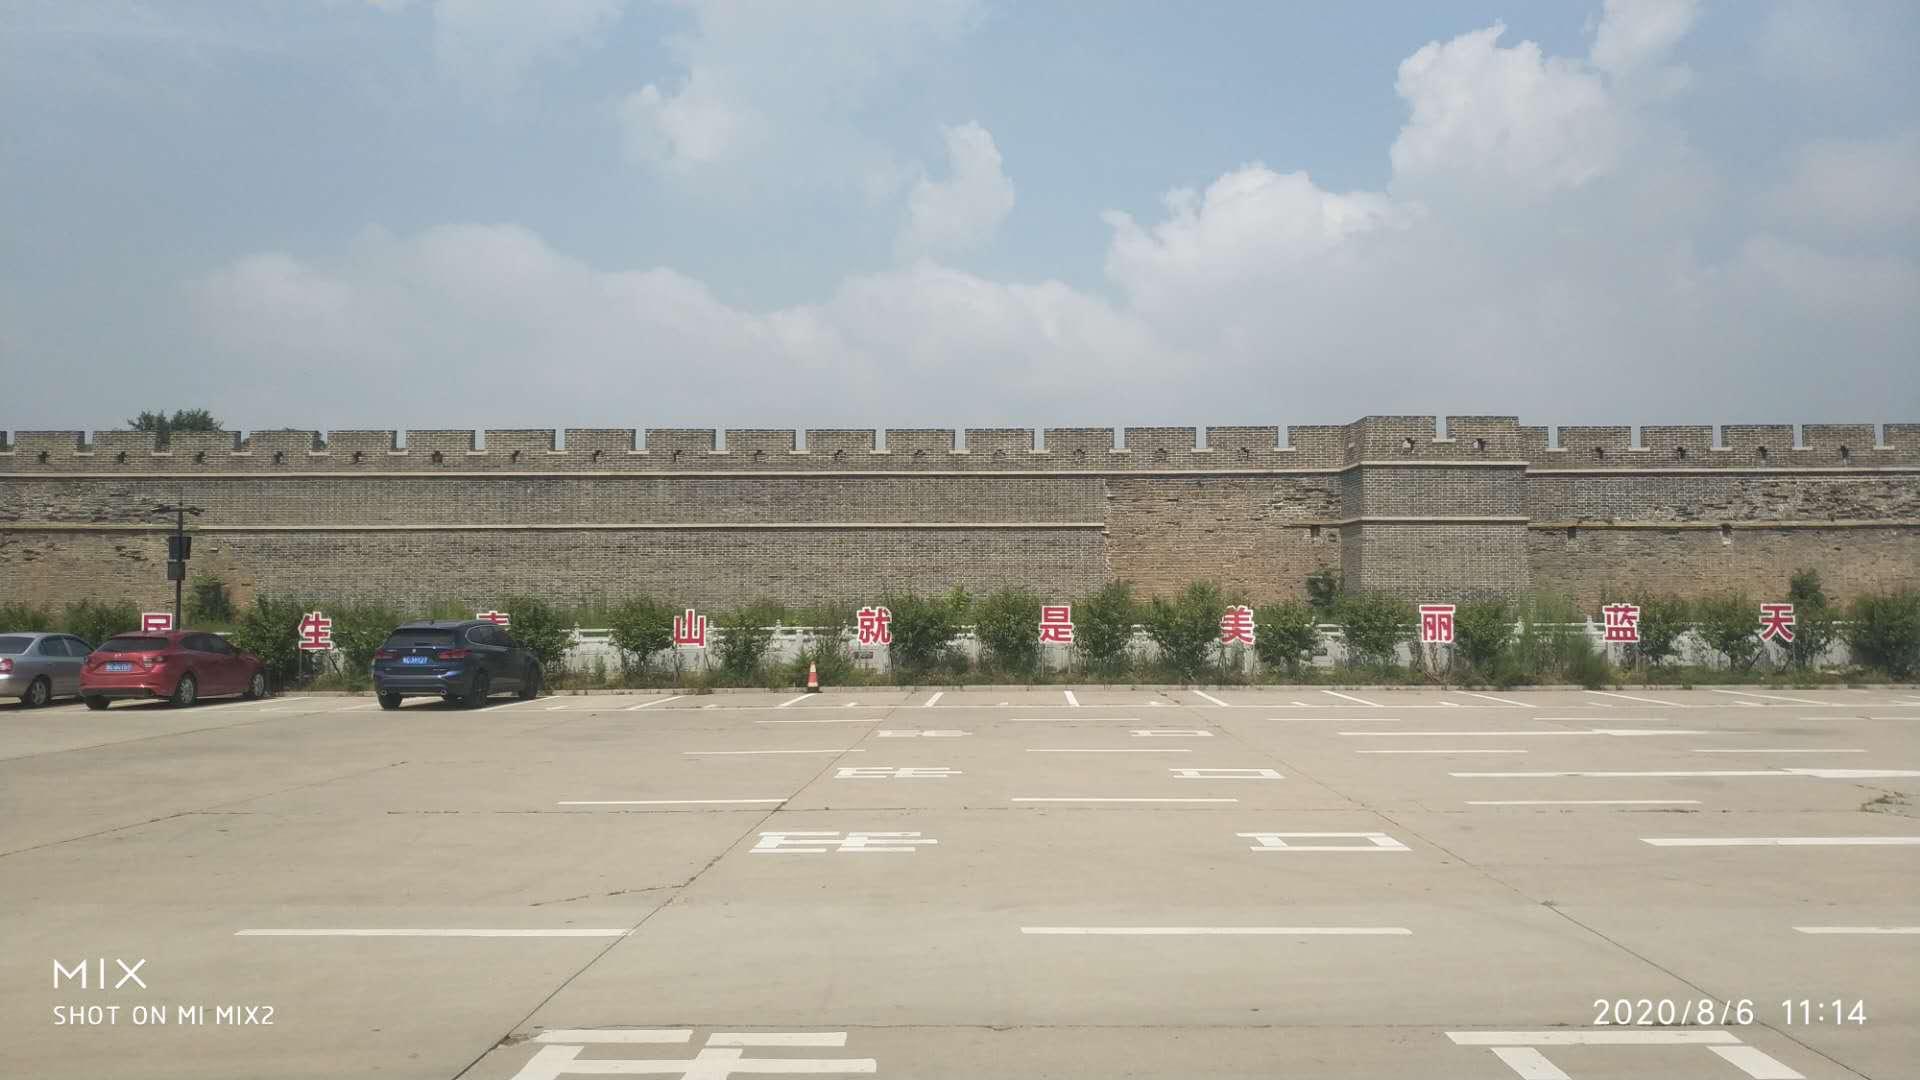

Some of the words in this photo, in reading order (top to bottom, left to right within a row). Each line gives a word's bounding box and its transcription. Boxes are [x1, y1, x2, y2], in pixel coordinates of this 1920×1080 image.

[300, 612, 332, 649] 生
[674, 610, 705, 648] 山
[858, 608, 892, 645] 就
[1040, 607, 1073, 643] 是
[1221, 606, 1254, 645] 美
[1421, 605, 1455, 642] 丽
[1604, 605, 1639, 641] 蓝
[1761, 604, 1794, 641] 天
